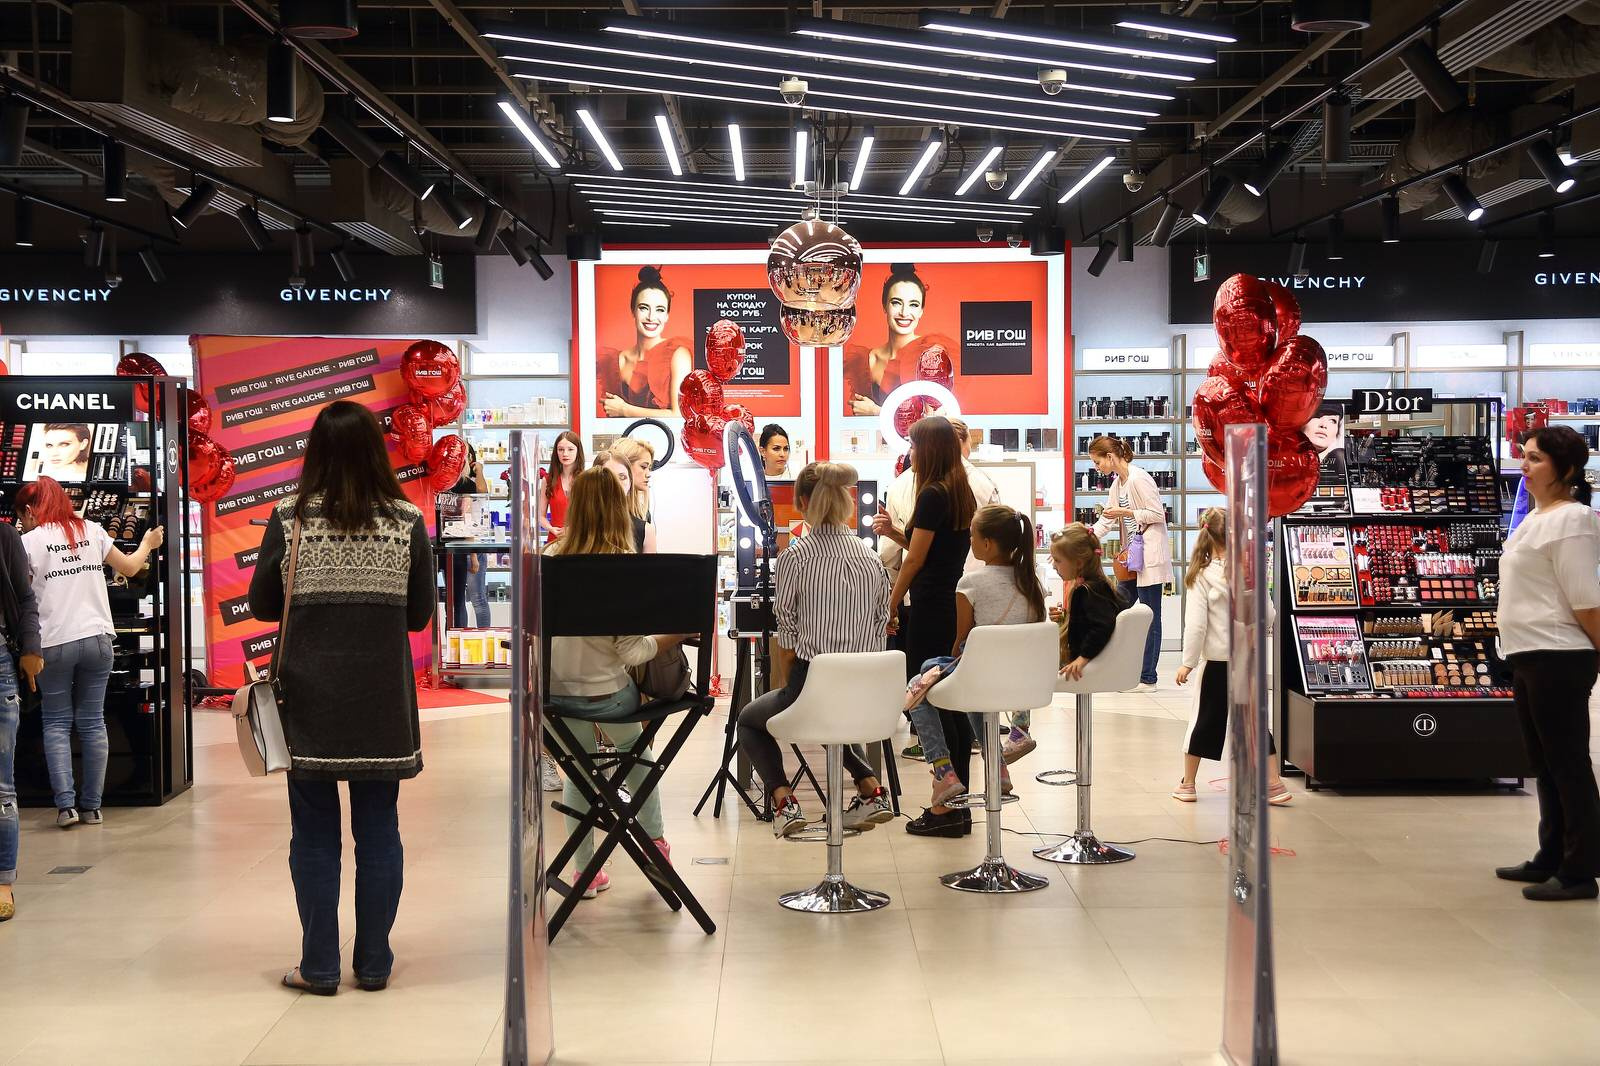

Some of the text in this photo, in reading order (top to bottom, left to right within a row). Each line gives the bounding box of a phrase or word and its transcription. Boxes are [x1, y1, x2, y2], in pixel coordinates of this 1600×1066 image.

[1258, 276, 1366, 288] VENCHY
[0, 289, 112, 301] GIVENCHY
[280, 288, 392, 301] GIVENCHY
[966, 330, 1026, 340] РИВ ГОШ
[230, 354, 374, 395] РИВ ГОШ RIVE GAUCHE РИВ ГОШ
[16, 393, 116, 410] CHANEL
[226, 380, 369, 422] РИВ ГОШ RIVE GAUCHE РИВ ГОШ
[1362, 391, 1423, 412] Dior
[258, 445, 284, 459] ГОШ
[396, 466, 424, 480] ИВ ГОШ
[218, 500, 235, 510] РИВ
[237, 495, 255, 504] ГОШ
[264, 487, 284, 498] RIVE
[46, 540, 90, 553] Красота
[62, 554, 81, 563] как
[250, 639, 272, 653] РИВ
[257, 669, 268, 677] ИВ
